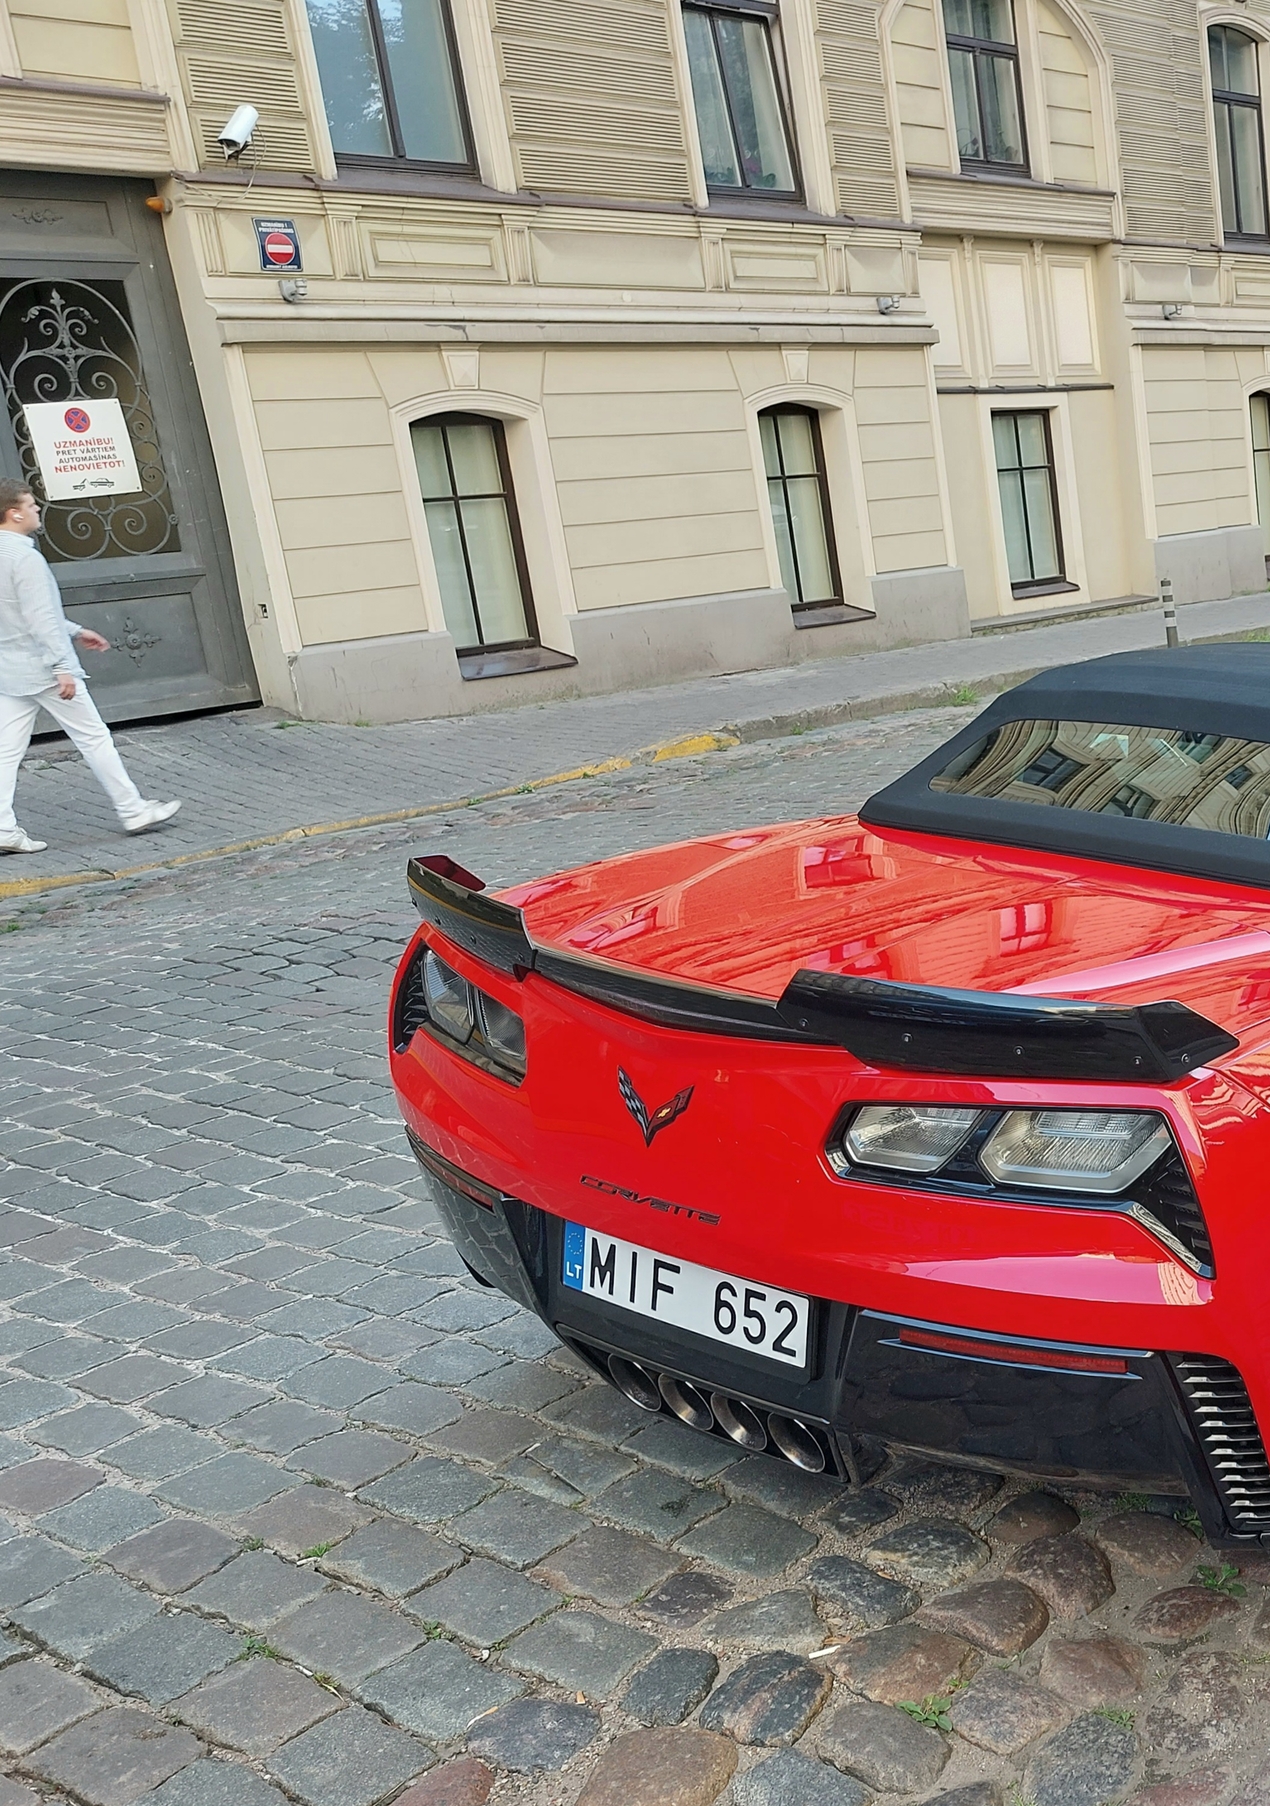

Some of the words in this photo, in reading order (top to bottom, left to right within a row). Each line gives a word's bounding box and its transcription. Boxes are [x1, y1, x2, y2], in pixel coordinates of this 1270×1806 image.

[54, 437, 114, 449] UZMANĪBU!
[80, 446, 116, 455] VĀRTIEM
[59, 453, 118, 464] AUTOMAŠĪNAS
[54, 460, 126, 473] NENOVIETOT!
[580, 1174, 721, 1226] CORVETTE
[566, 1261, 582, 1280] LT
[589, 1236, 681, 1312] MIF
[713, 1281, 798, 1358] 652
